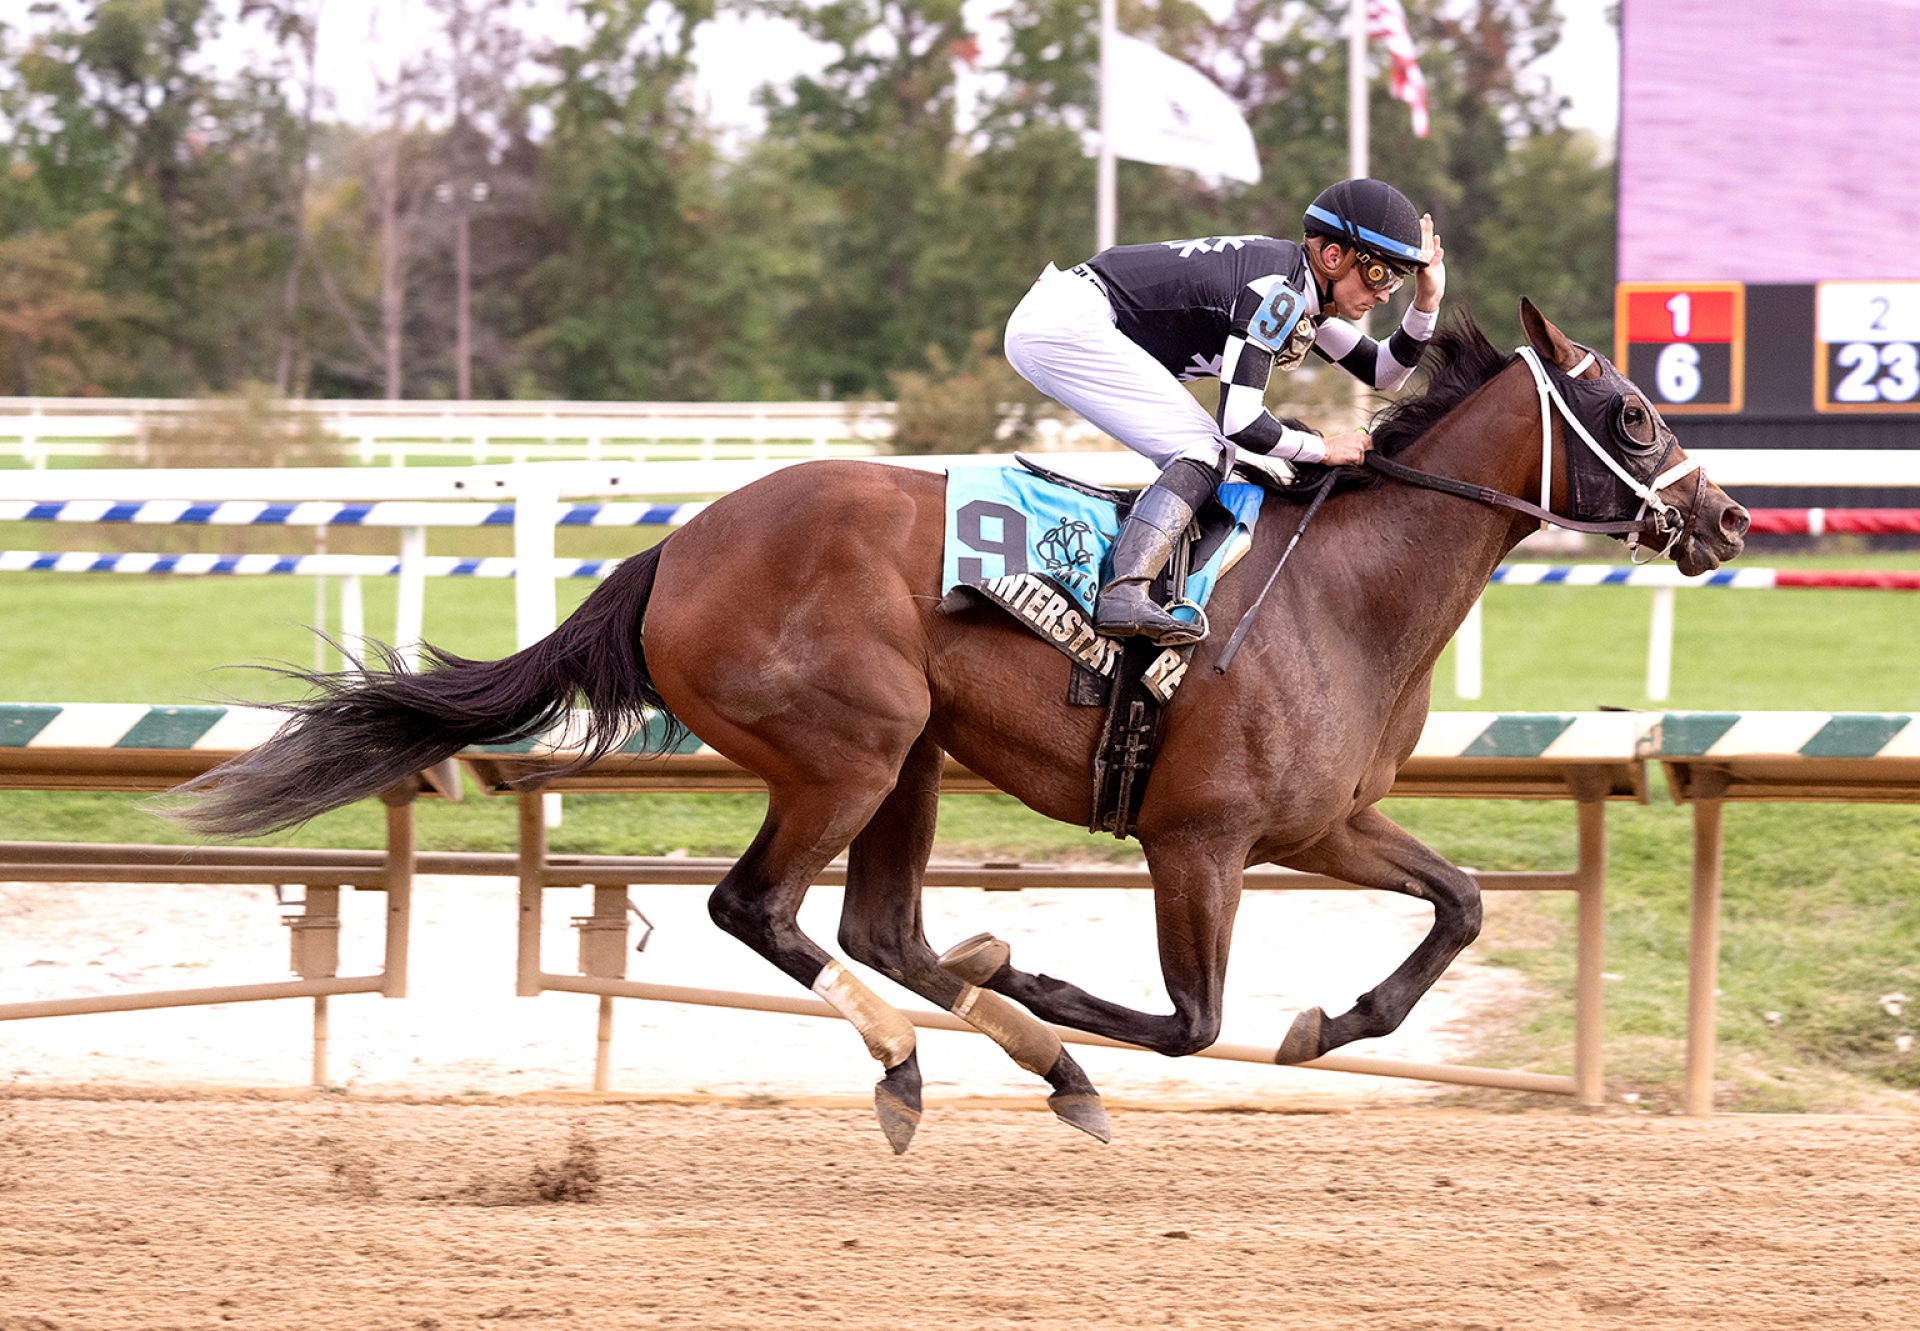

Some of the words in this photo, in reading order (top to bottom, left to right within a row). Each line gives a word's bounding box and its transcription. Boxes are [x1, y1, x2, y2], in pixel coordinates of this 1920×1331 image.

[1259, 292, 1296, 341] 9
[1665, 292, 1691, 338] 1
[1869, 296, 1891, 331] 2
[1655, 342, 1701, 403] 6
[1835, 341, 1920, 402] 23
[957, 500, 1029, 585] 9
